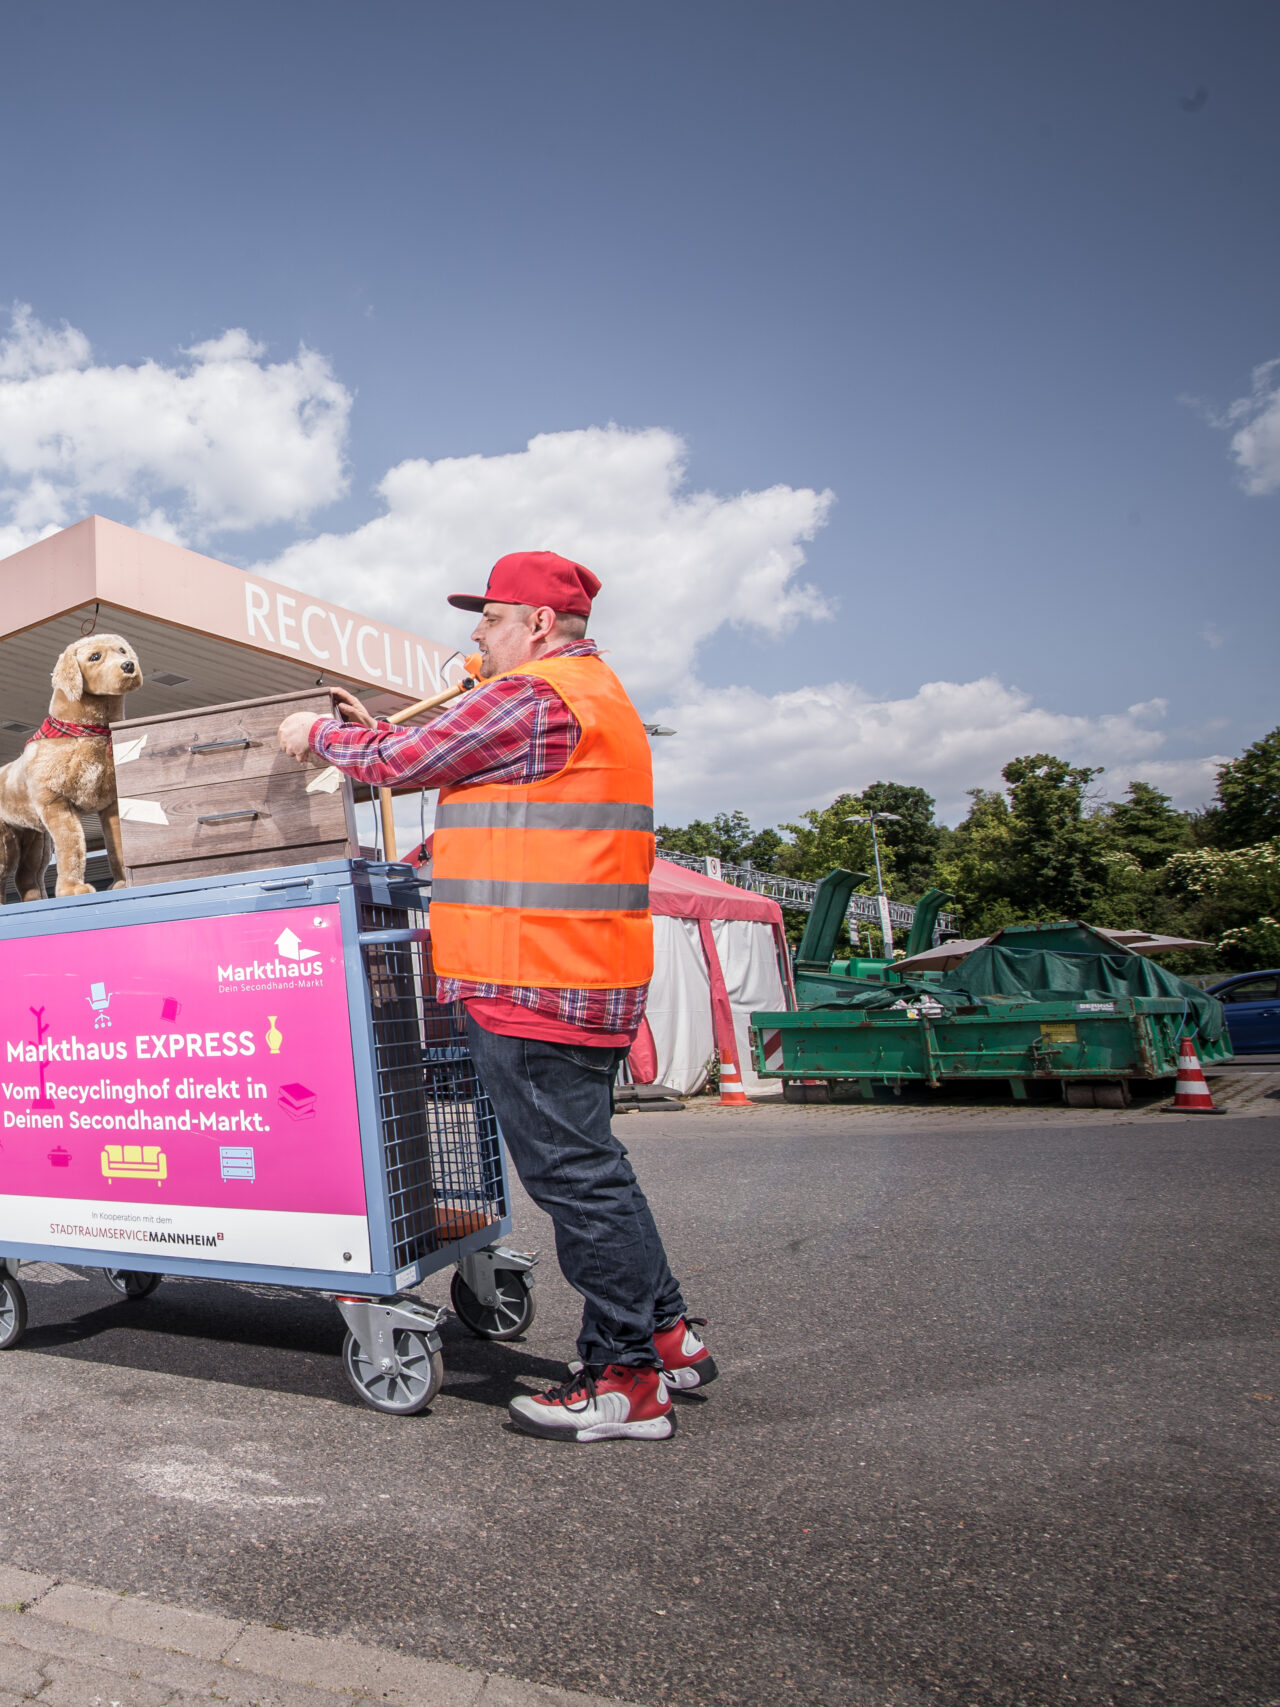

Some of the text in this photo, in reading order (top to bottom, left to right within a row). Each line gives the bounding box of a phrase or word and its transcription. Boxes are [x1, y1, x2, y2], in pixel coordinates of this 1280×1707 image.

[217, 959, 323, 982] Markthaus
[219, 979, 323, 993] Dein Secondhand-Markt
[7, 1031, 255, 1063] Markthaus EXPRESS
[2, 1077, 268, 1104] Vom Recyclinghof direkt in
[3, 1109, 271, 1132] Deinen Secondhand-Markt.
[99, 1212, 141, 1223] Kooperation
[143, 1215, 154, 1224] mit
[156, 1216, 173, 1225] dem
